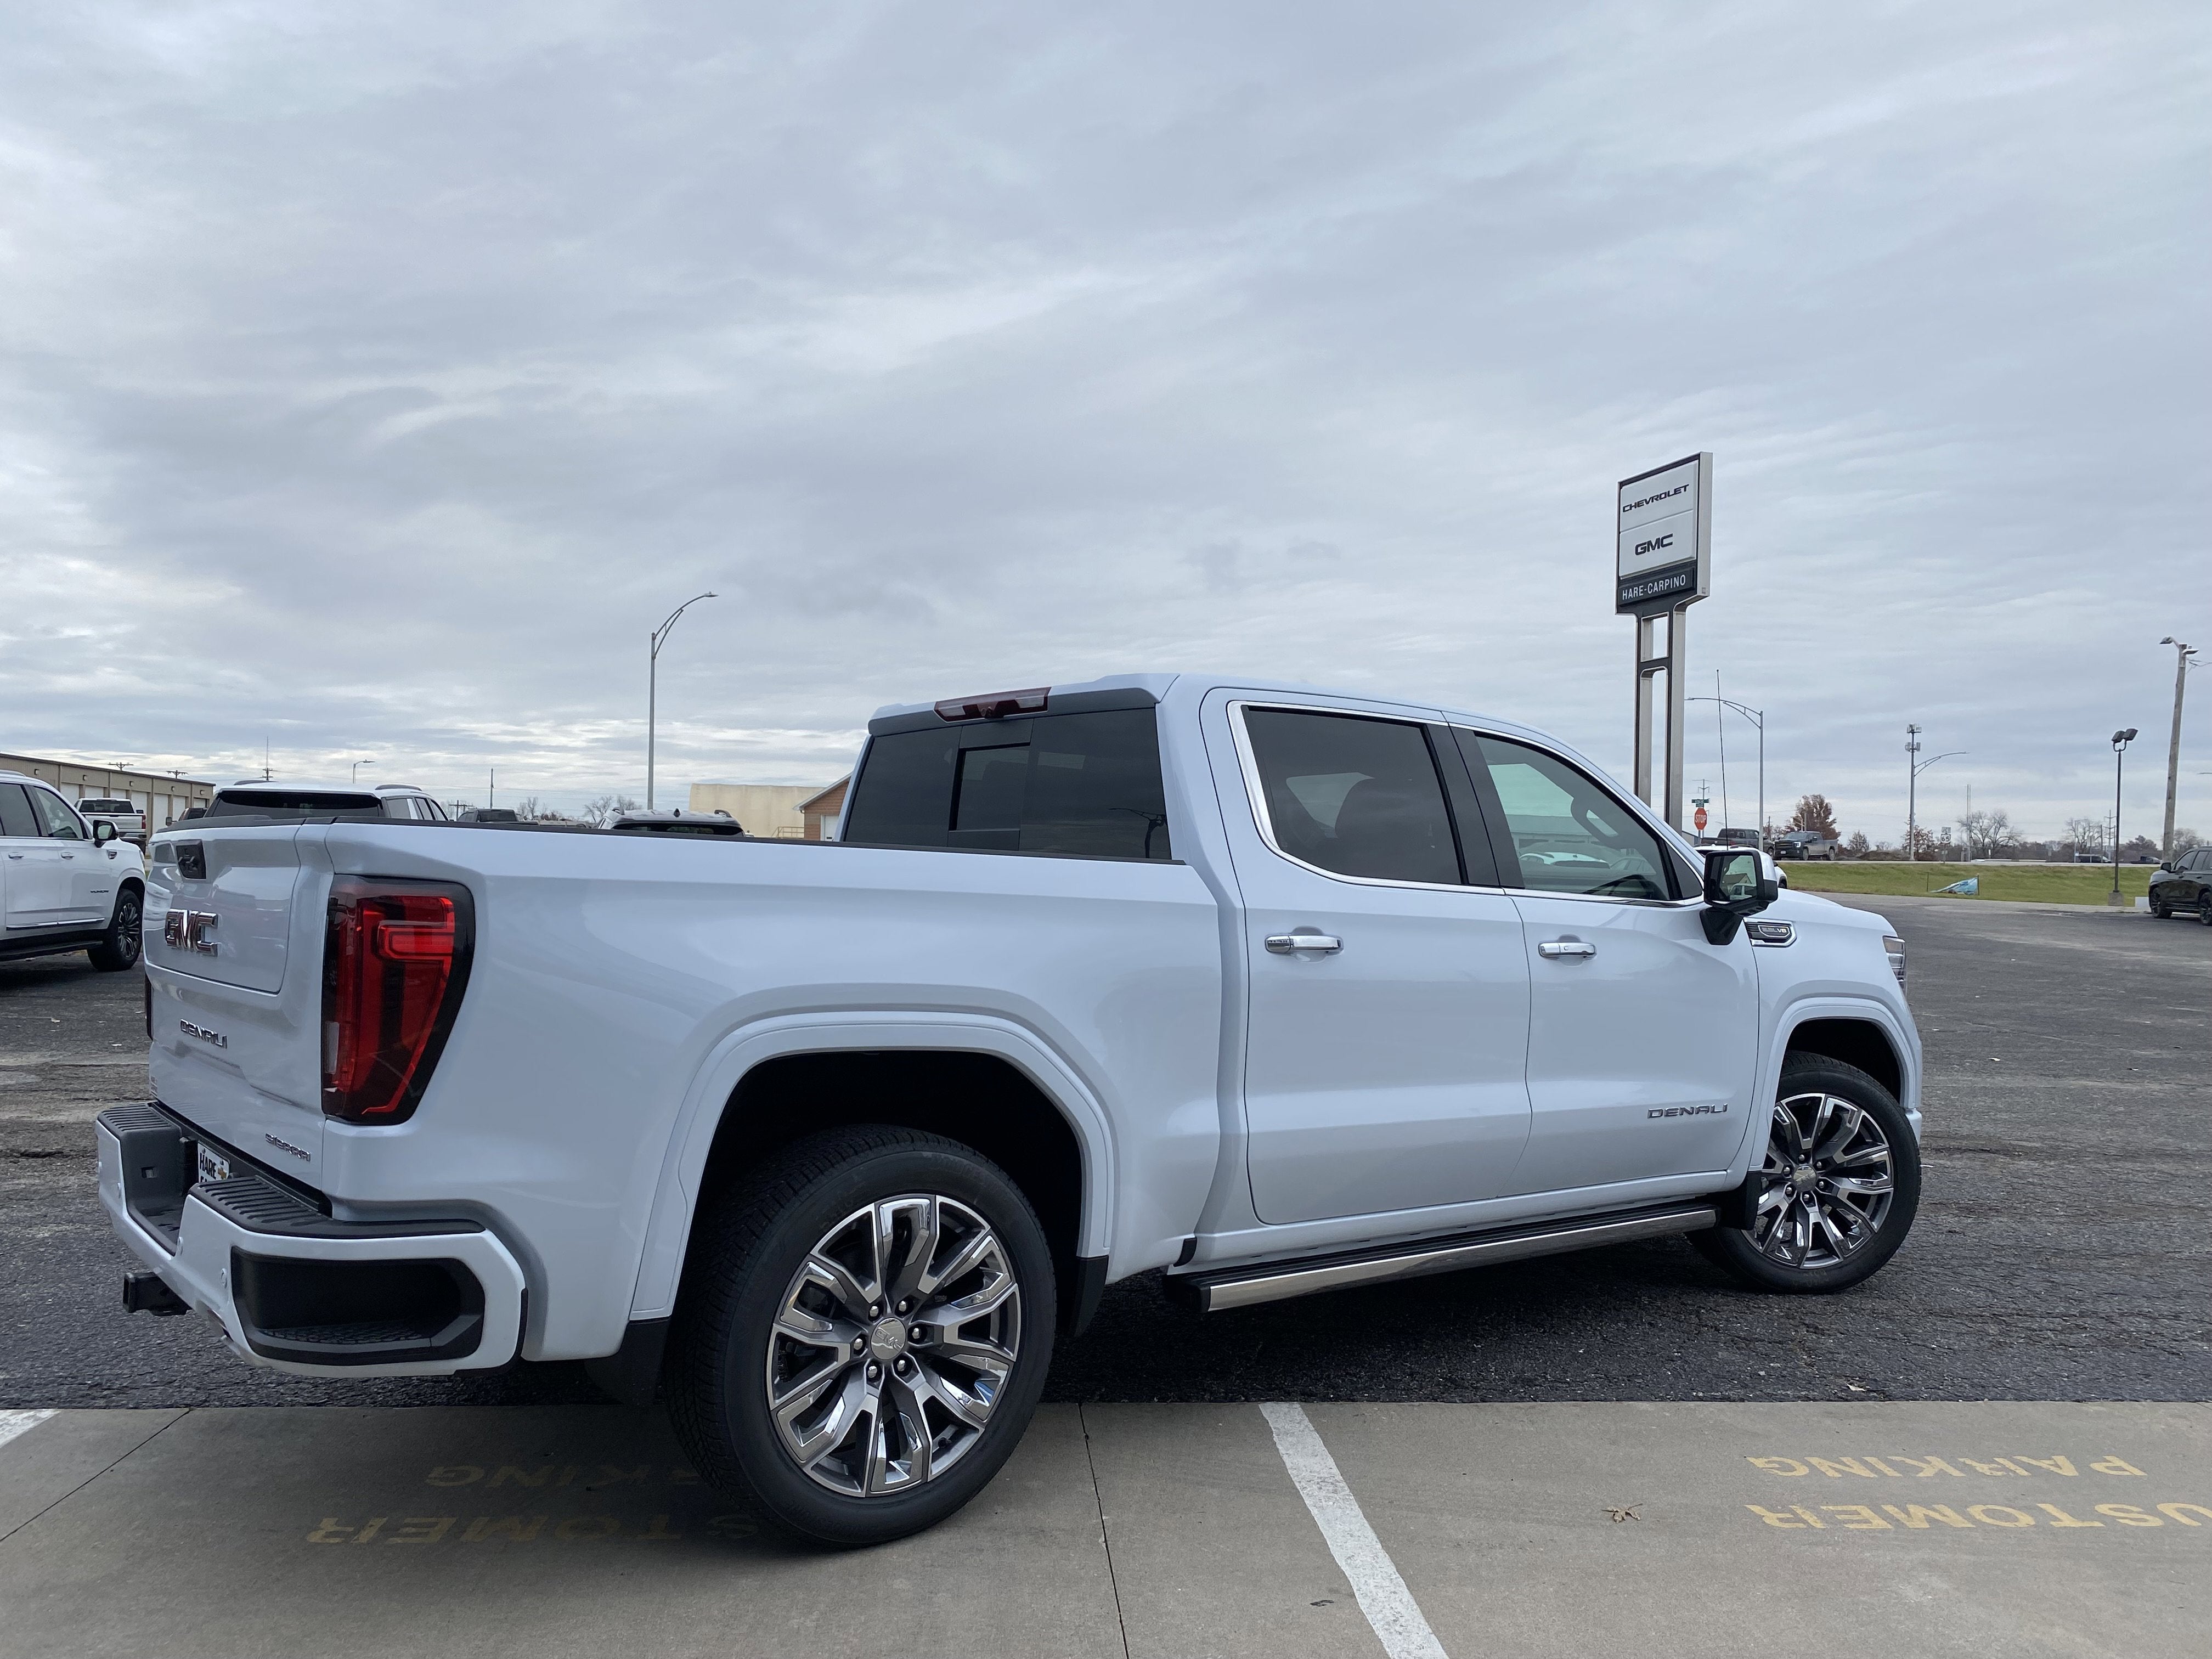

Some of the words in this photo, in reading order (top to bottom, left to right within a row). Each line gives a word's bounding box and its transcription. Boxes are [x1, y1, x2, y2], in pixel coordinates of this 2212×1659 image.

[1622, 484, 1689, 512] CHEVROLET
[1635, 533, 1673, 556] GMC
[1622, 574, 1686, 600] HARE-CARPINO
[1695, 814, 1707, 823] STOP
[165, 909, 218, 957] GMC
[180, 1018, 228, 1049] DENALI
[1647, 1103, 1728, 1119] DENALI
[265, 1133, 311, 1162] SIERRA
[200, 1152, 217, 1180] HARE
[1746, 1455, 2148, 1477] PARKING
